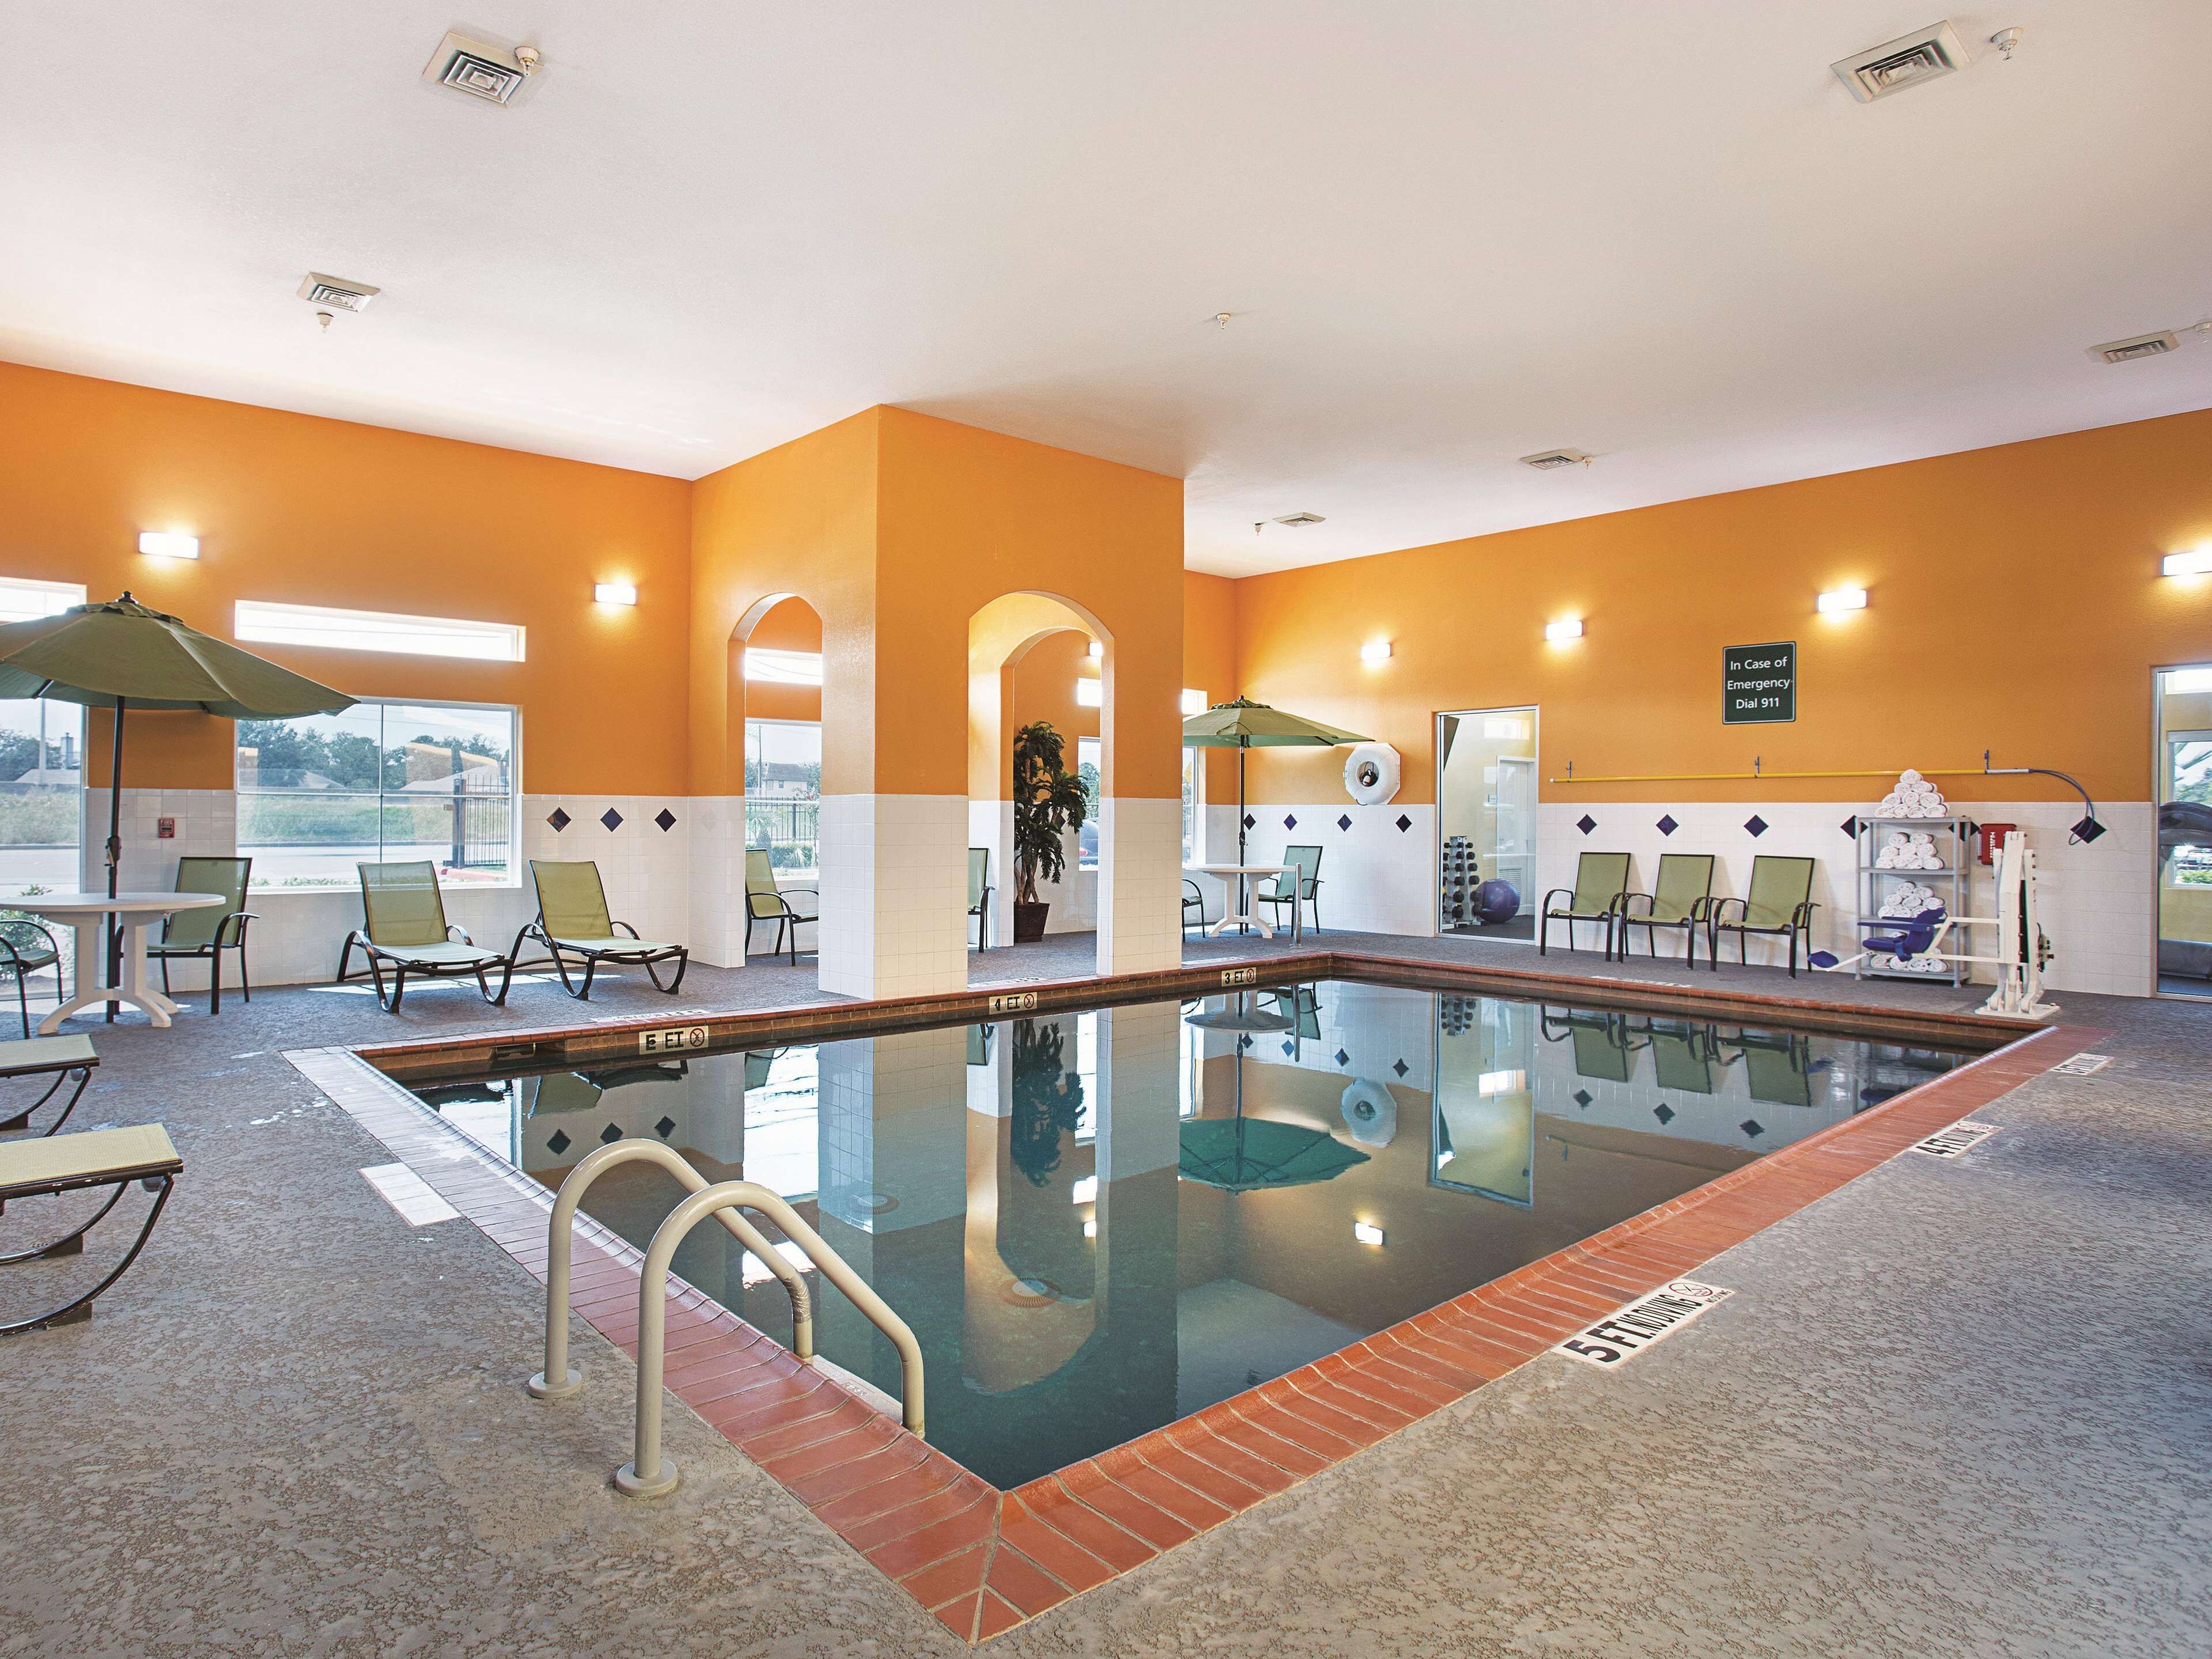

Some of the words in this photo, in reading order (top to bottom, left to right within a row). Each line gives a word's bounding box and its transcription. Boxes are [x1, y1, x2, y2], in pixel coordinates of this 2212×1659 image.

[1730, 661, 1741, 670] In
[1745, 660, 1771, 670] Case
[1774, 656, 1787, 667] of
[1727, 679, 1790, 691] Emergency
[1736, 698, 1757, 709] Dial
[1761, 697, 1779, 708] 911
[1915, 1146, 1956, 1155] 4
[1631, 1294, 1703, 1323] DIVING
[1616, 1314, 1668, 1332] NO
[1563, 1339, 1621, 1363] 5
